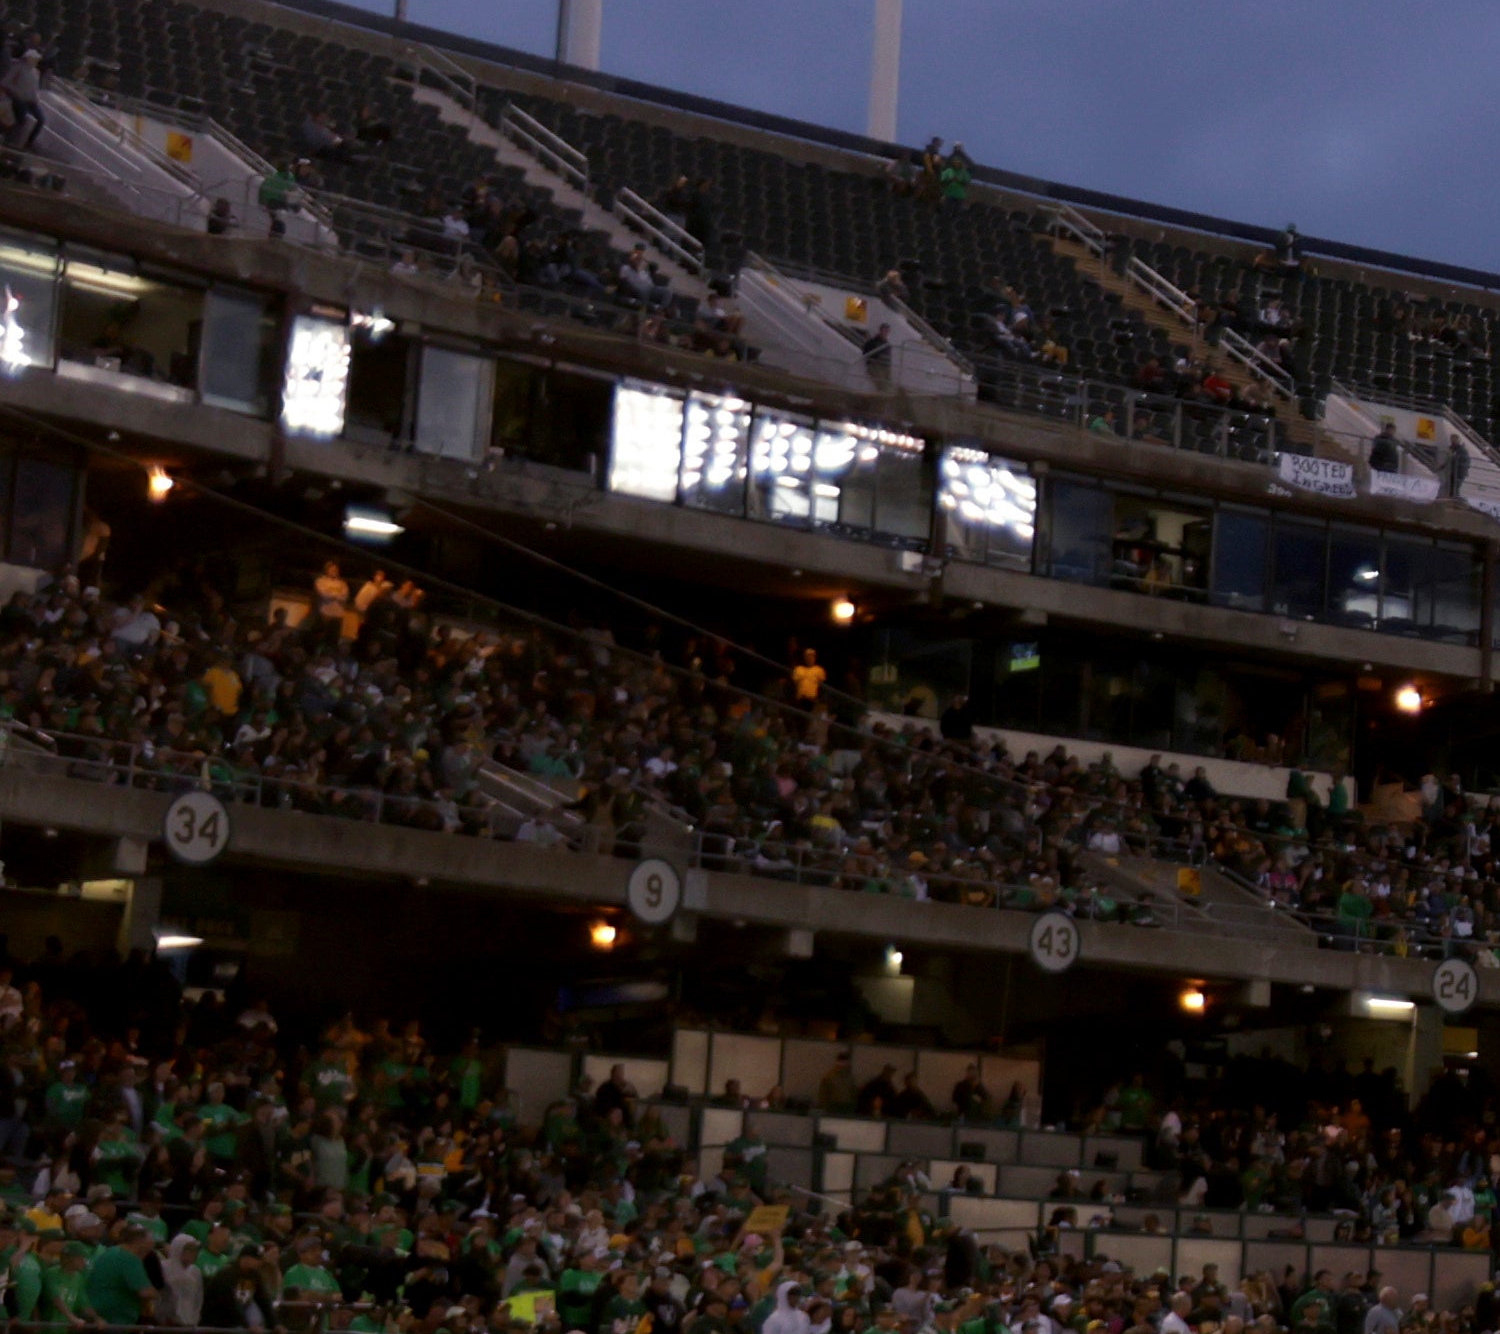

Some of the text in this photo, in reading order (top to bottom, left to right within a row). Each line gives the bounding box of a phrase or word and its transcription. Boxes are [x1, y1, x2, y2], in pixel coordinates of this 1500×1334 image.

[174, 804, 219, 848] 34
[647, 873, 663, 908] 9
[1038, 925, 1072, 958] 43
[1440, 969, 1470, 1000] 24
